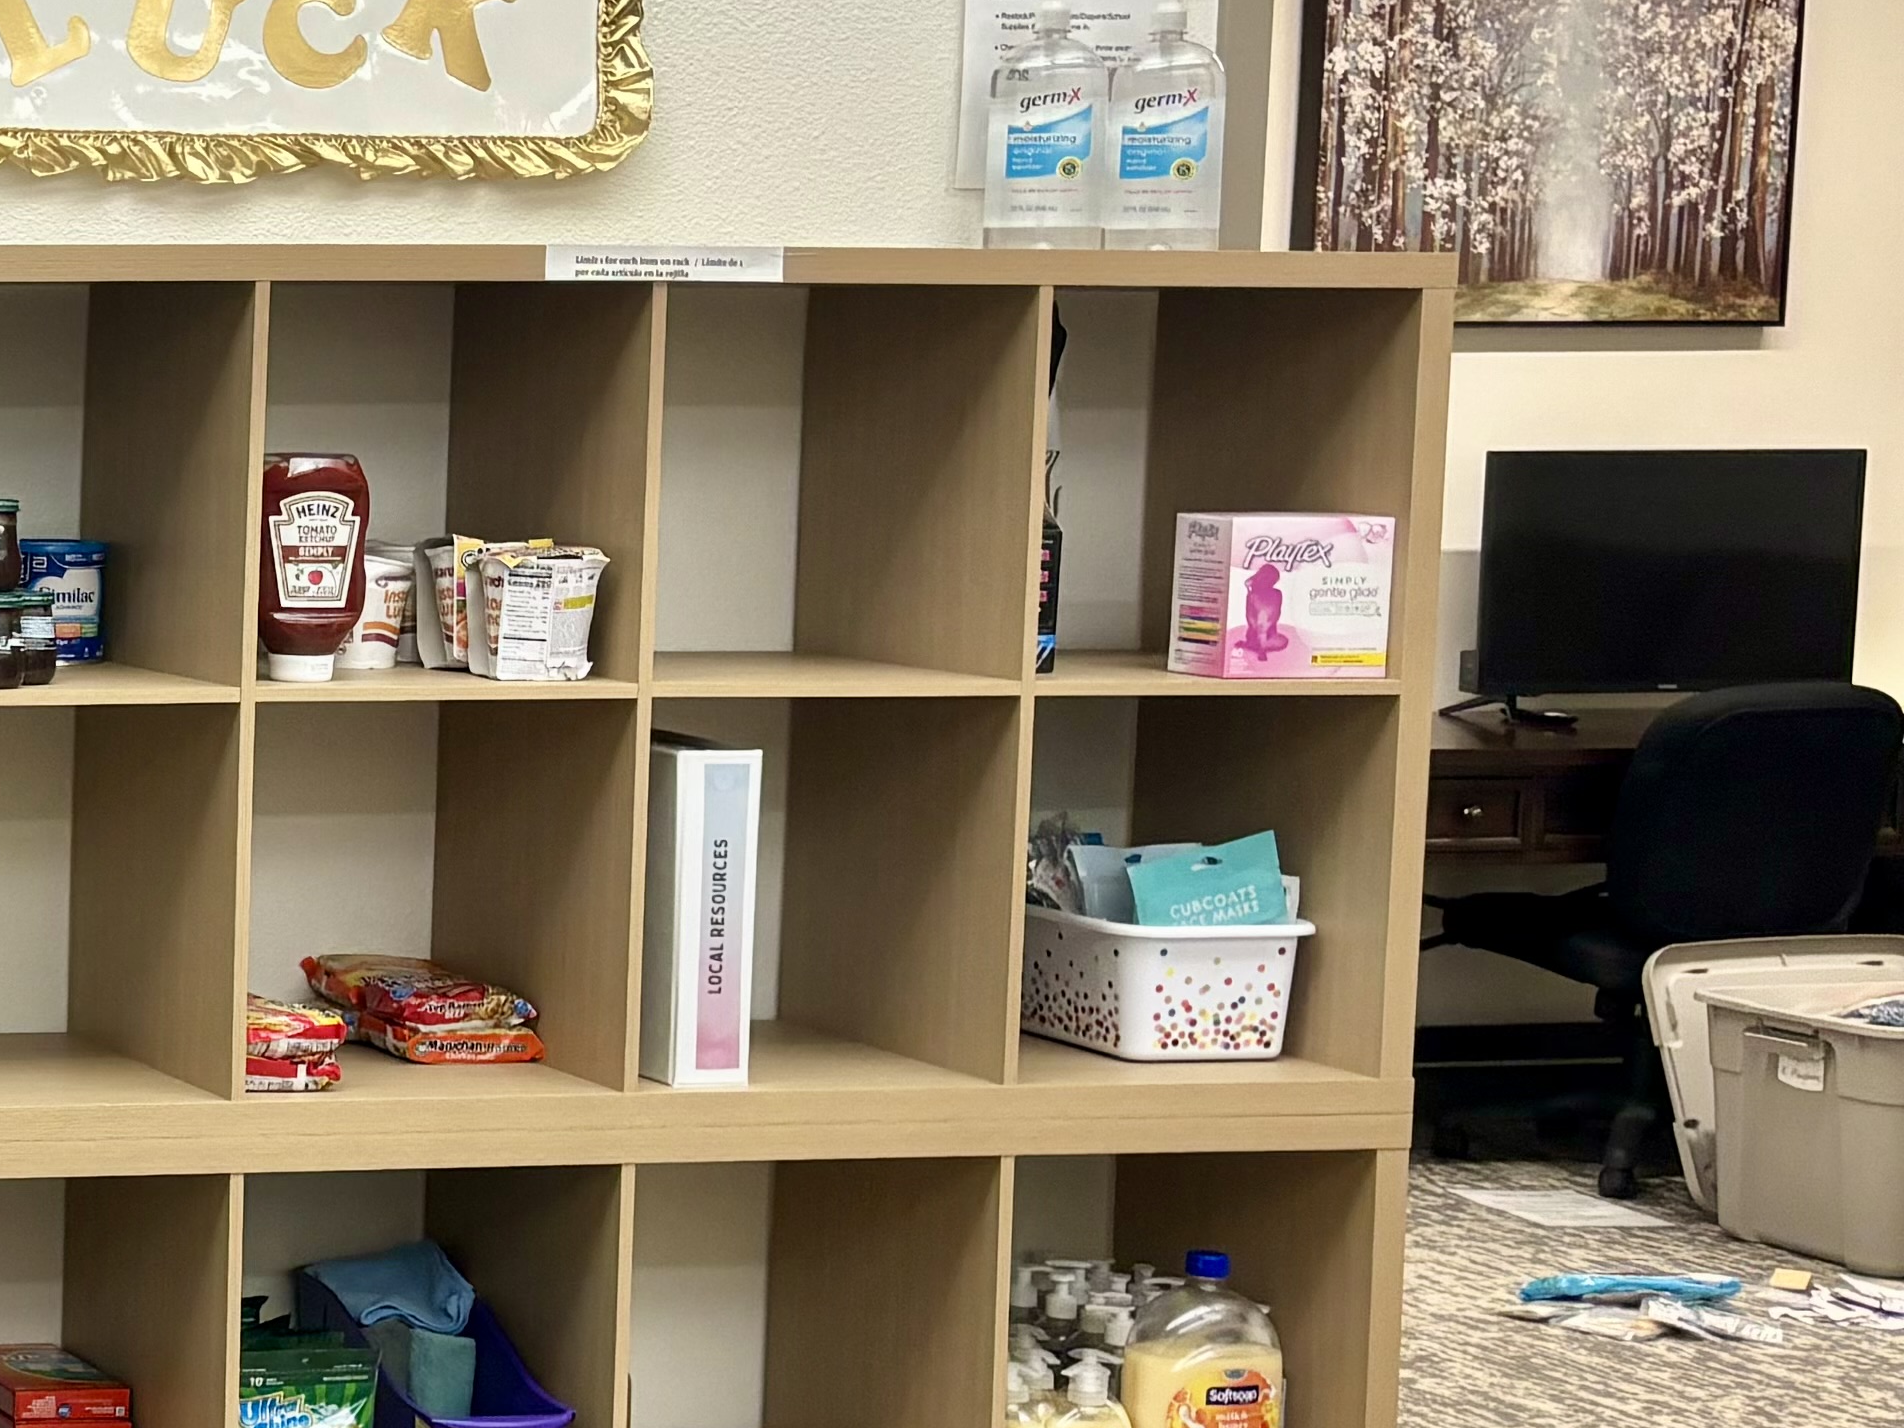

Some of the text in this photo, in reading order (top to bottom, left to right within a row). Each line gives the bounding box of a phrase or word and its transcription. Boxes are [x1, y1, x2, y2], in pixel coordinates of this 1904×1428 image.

[296, 502, 339, 519] HEINZ
[297, 524, 337, 535] TOMATO
[299, 534, 335, 543] KETCHUP
[298, 546, 334, 557] SIMPLY
[1243, 536, 1333, 571] Playtex
[1322, 576, 1367, 585] SIMPLY
[1310, 587, 1378, 600] gentle glide
[1170, 885, 1256, 918] CUBCOATS
[708, 839, 729, 994] LOCAL RESOURCES
[250, 1376, 263, 1387] 10
[1209, 1388, 1257, 1403] Softsoap
[240, 1397, 304, 1423] Ultra
